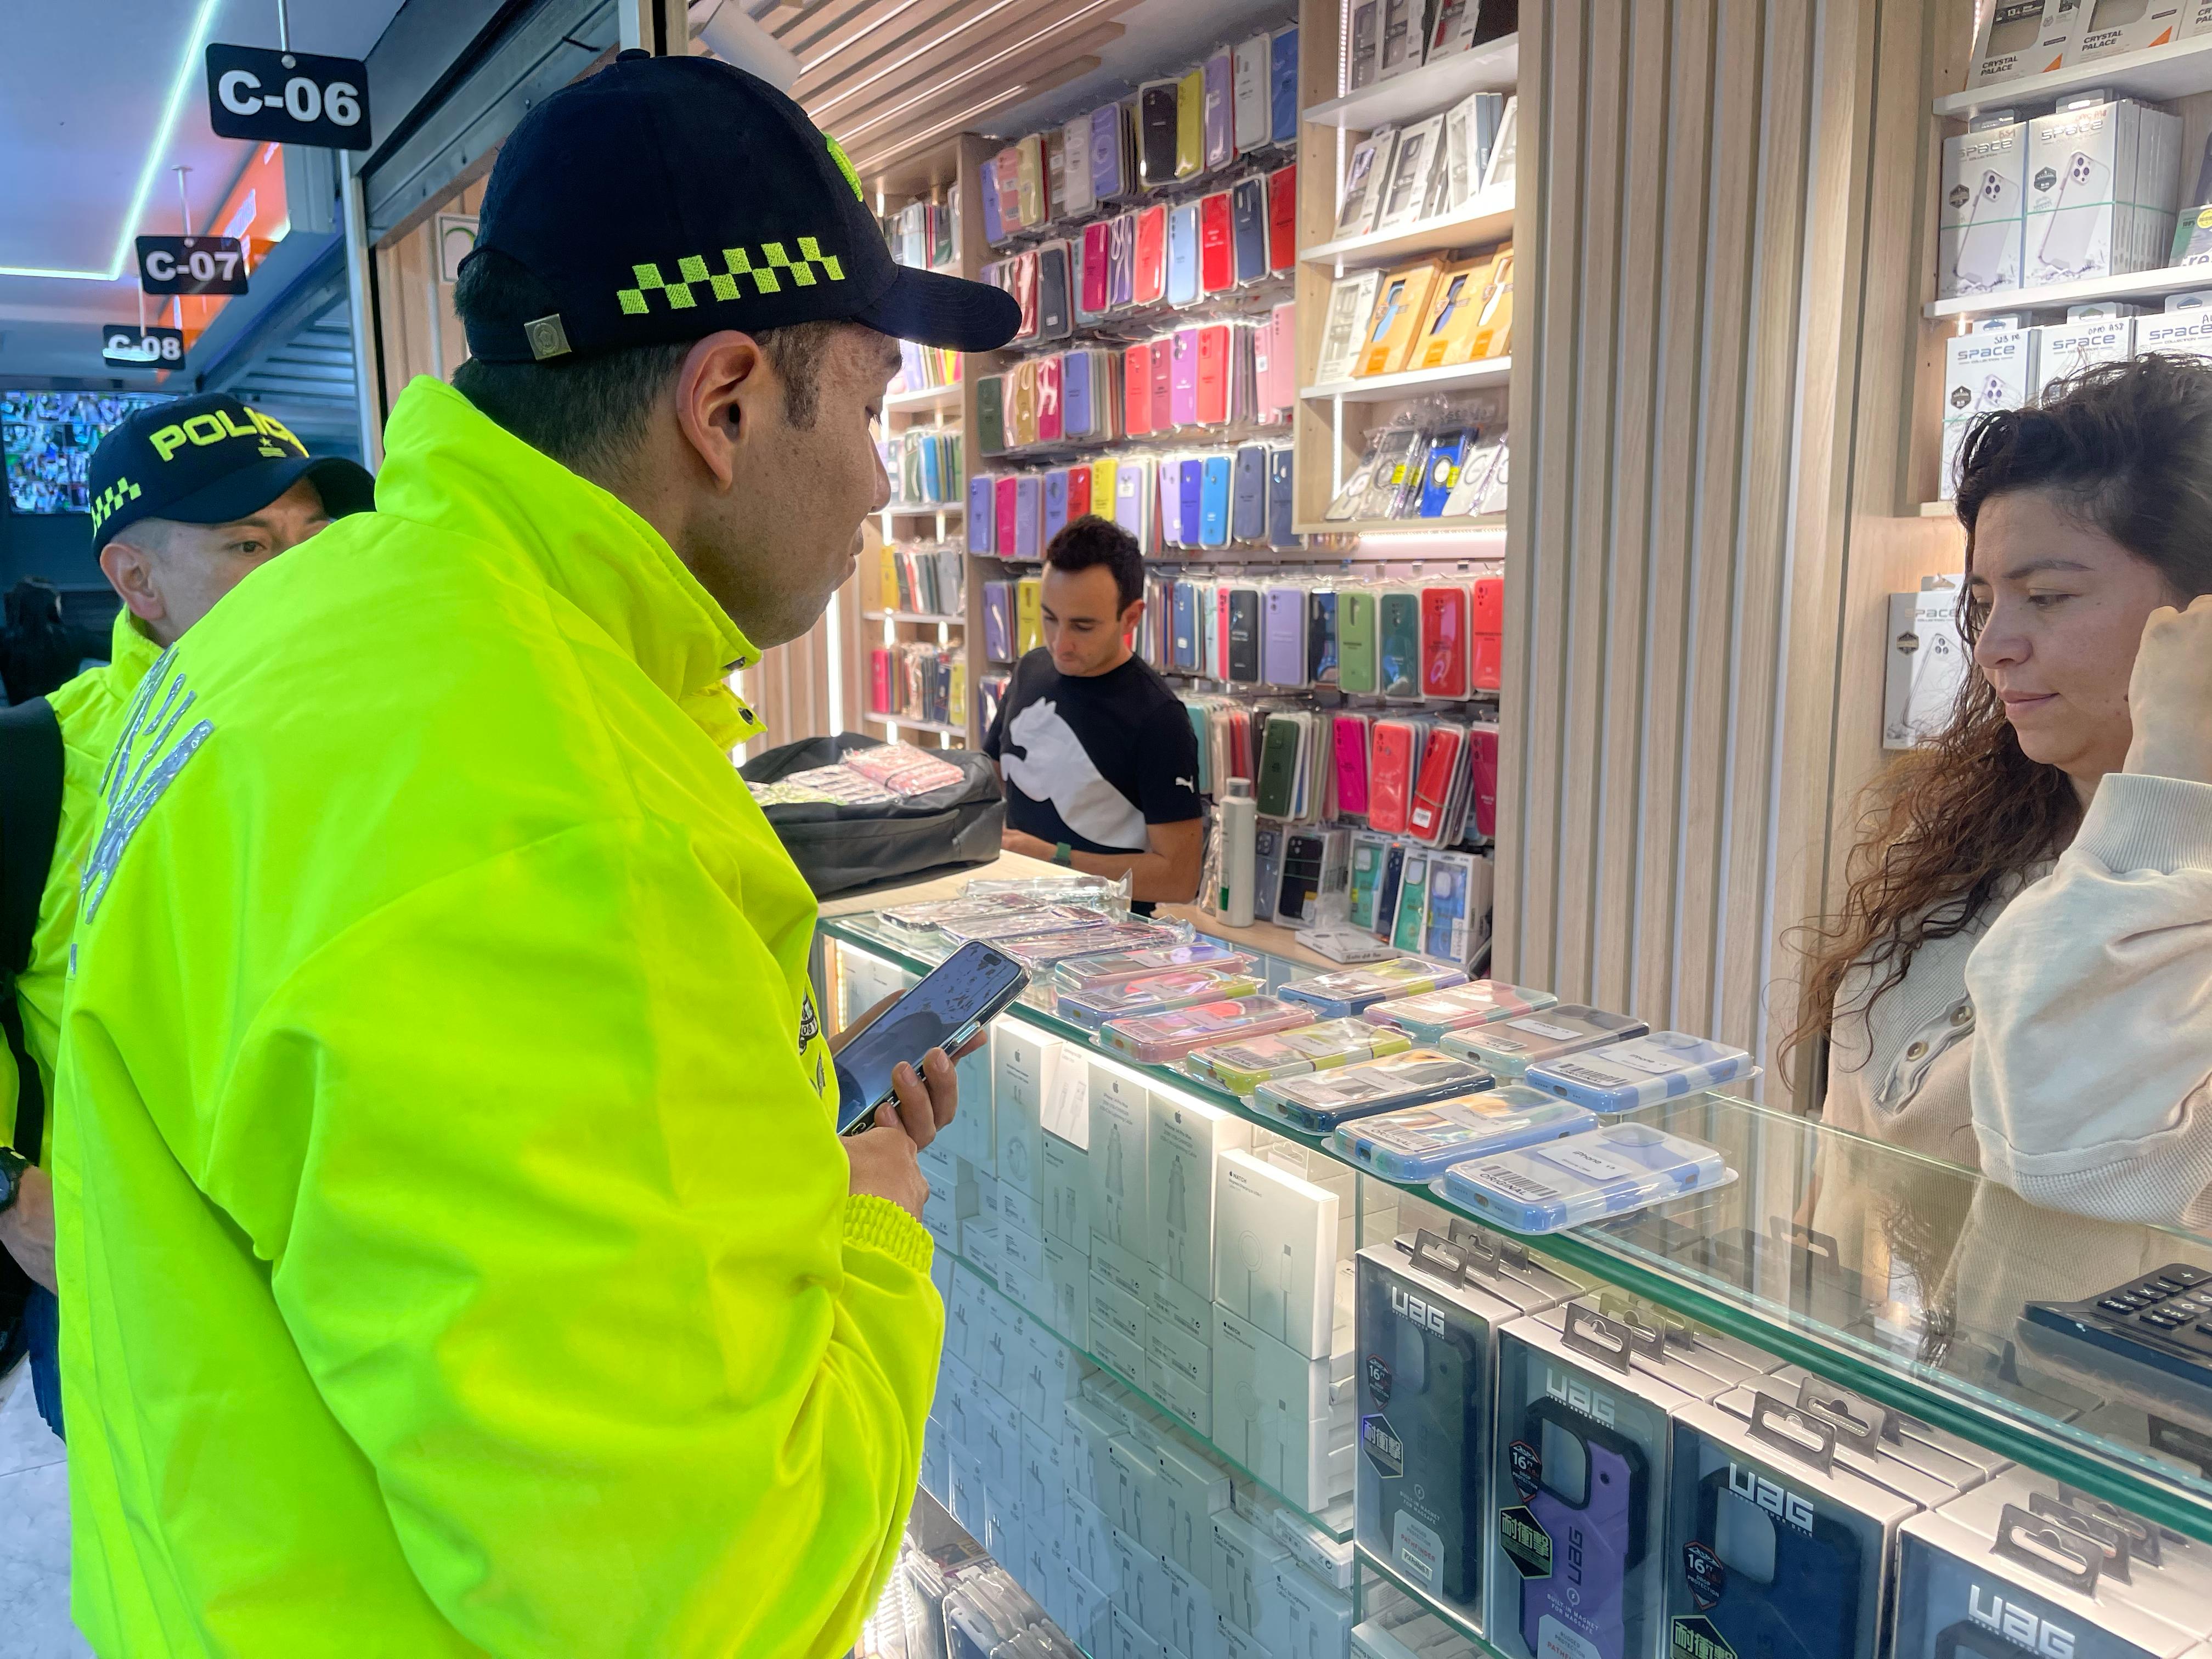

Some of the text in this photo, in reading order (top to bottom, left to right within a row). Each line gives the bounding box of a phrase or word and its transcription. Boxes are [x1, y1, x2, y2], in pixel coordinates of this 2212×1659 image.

[2082, 38, 2117, 51] PALACE
[2084, 30, 2123, 44] CRYSTAL
[1981, 64, 2012, 76] PALACE
[1982, 55, 2018, 69] CRYSTAL
[218, 70, 362, 127] C-06
[145, 251, 239, 282] C-07
[107, 334, 180, 361] C-08
[1629, 1054, 1655, 1063] iPhone
[1572, 1150, 1602, 1165] iPhone
[1480, 1173, 1528, 1196] ORIGINAL
[1392, 1286, 1445, 1336] UAG
[1546, 1368, 1615, 1426] UAG
[1512, 1471, 1538, 1491] PROTECTION
[1519, 1470, 1531, 1480] DROP
[1729, 1462, 1814, 1533] UAG
[1403, 1498, 1436, 1525] FOR MAGSAFE
[1420, 1503, 1441, 1522] MAGNET
[1401, 1533, 1436, 1563] PATHFINDER
[1688, 1575, 1719, 1599] PROTECTION
[1696, 1575, 1711, 1586] DROP
[1547, 1593, 1599, 1632] BUILT-IN MAGNET
[1551, 1603, 1594, 1635] FOR MAGSAFE
[1968, 1584, 2076, 1659] UAG
[1555, 1634, 1585, 1658] PROTECTION
[1560, 1631, 1581, 1649] RUGGED
